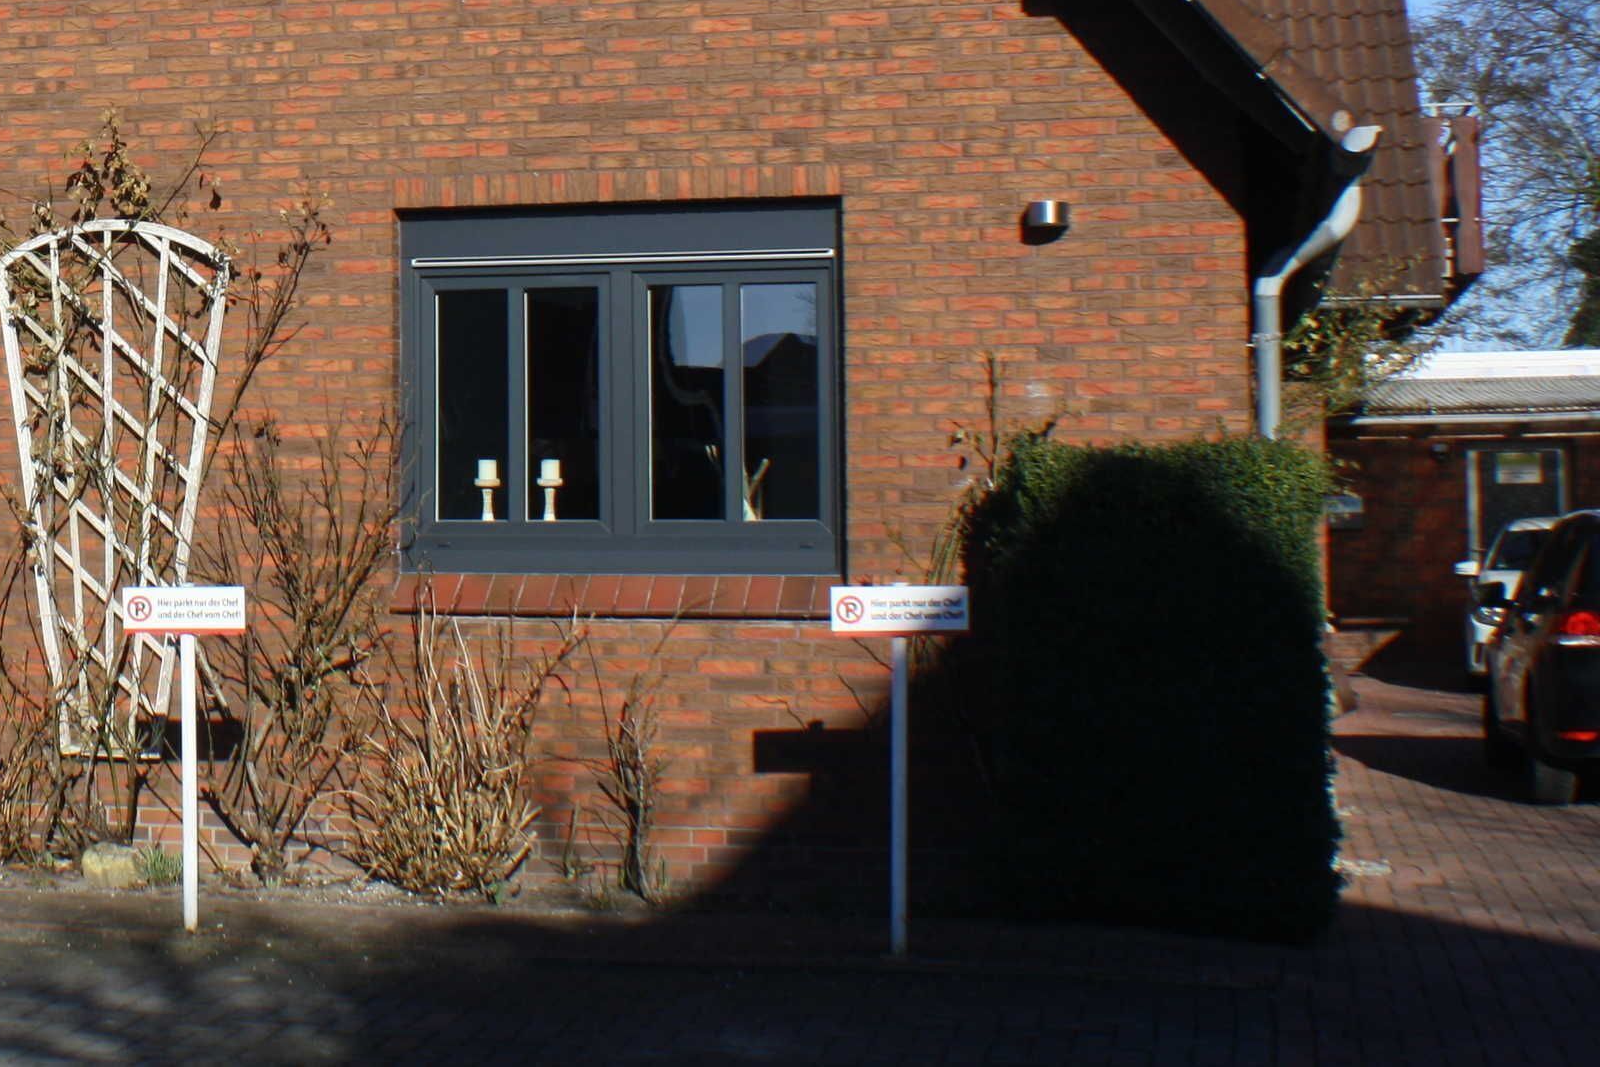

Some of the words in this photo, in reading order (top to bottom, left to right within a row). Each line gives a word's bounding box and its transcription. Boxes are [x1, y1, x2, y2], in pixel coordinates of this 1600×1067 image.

[157, 598, 172, 607] Hier
[174, 598, 193, 609] parkt
[221, 598, 238, 607] Chef
[157, 610, 172, 619] und
[173, 610, 185, 619] der
[186, 610, 203, 619] Chef
[205, 611, 220, 619] vom
